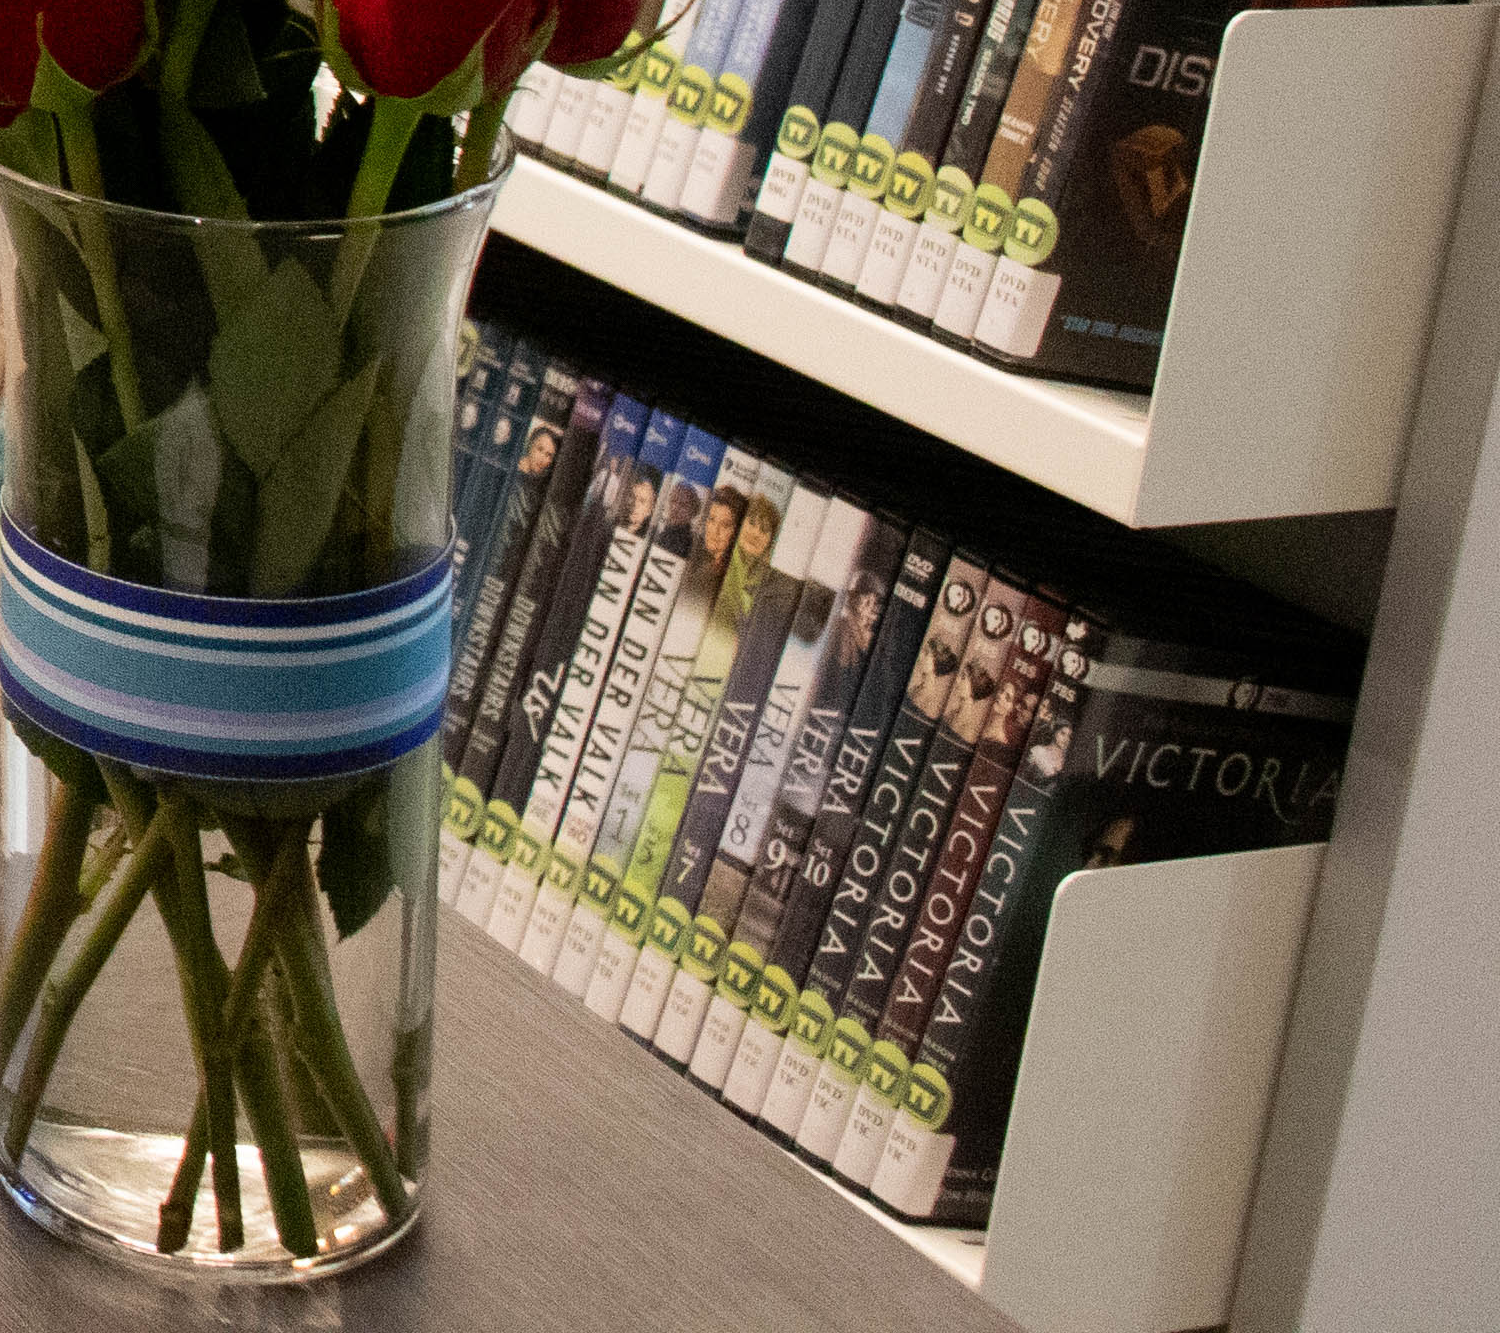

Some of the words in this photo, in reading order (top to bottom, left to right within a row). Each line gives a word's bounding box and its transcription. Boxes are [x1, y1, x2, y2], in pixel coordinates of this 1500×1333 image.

[598, 533, 637, 605] VAN
[630, 554, 676, 626] VAN
[569, 620, 610, 688] DER
[603, 637, 647, 710] DER
[538, 700, 584, 791] VALK
[628, 653, 694, 754] VERA
[662, 677, 723, 776] VERA
[749, 684, 800, 770] VERA
[571, 723, 622, 811] VALK
[697, 701, 757, 796] VERA
[822, 727, 879, 815] VERA
[767, 839, 787, 871] 9
[804, 855, 830, 887] 10
[820, 737, 922, 953] VICTORIA
[857, 762, 959, 980] VICTORIA
[897, 784, 997, 1004] VICTORIA
[935, 808, 1036, 1024] VICTORIA
